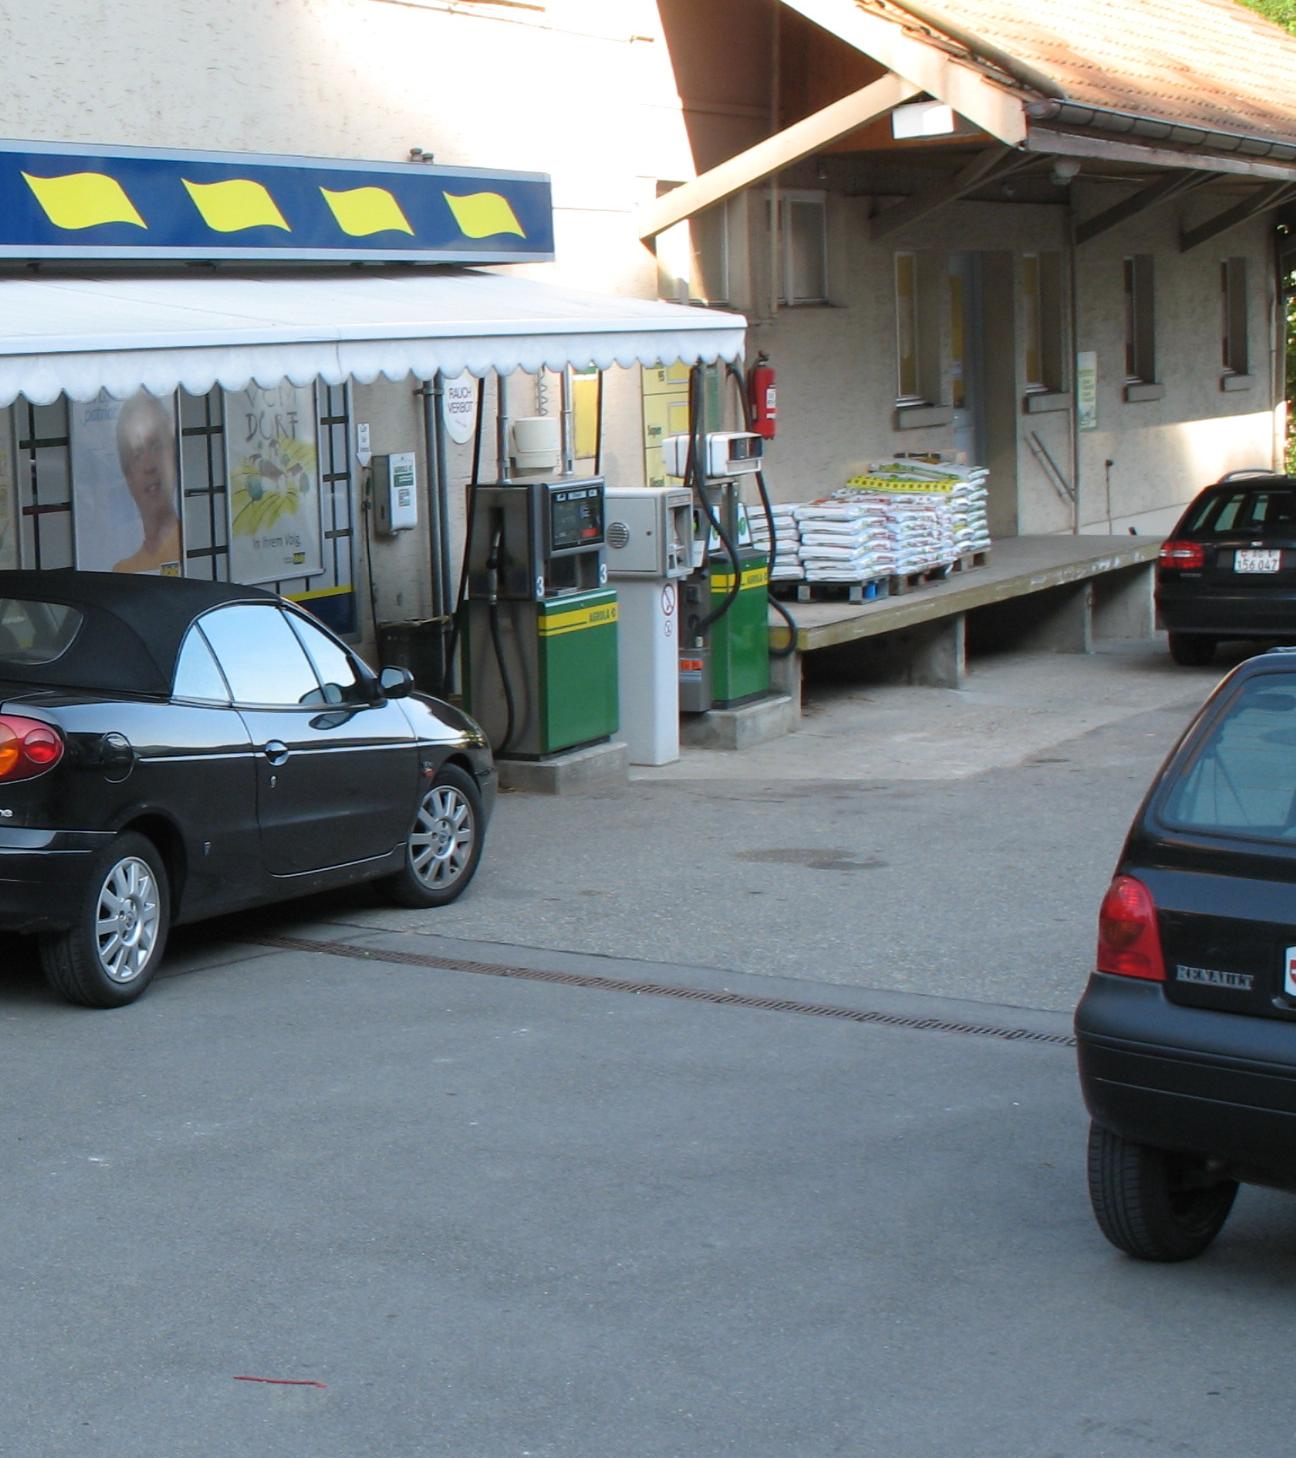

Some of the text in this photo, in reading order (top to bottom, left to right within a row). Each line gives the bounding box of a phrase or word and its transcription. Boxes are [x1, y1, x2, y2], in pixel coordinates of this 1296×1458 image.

[448, 401, 473, 414] VERBOT
[245, 411, 299, 443] DORF
[600, 563, 608, 584] 3
[536, 576, 545, 597] 3
[1176, 964, 1254, 991] RENAULT
